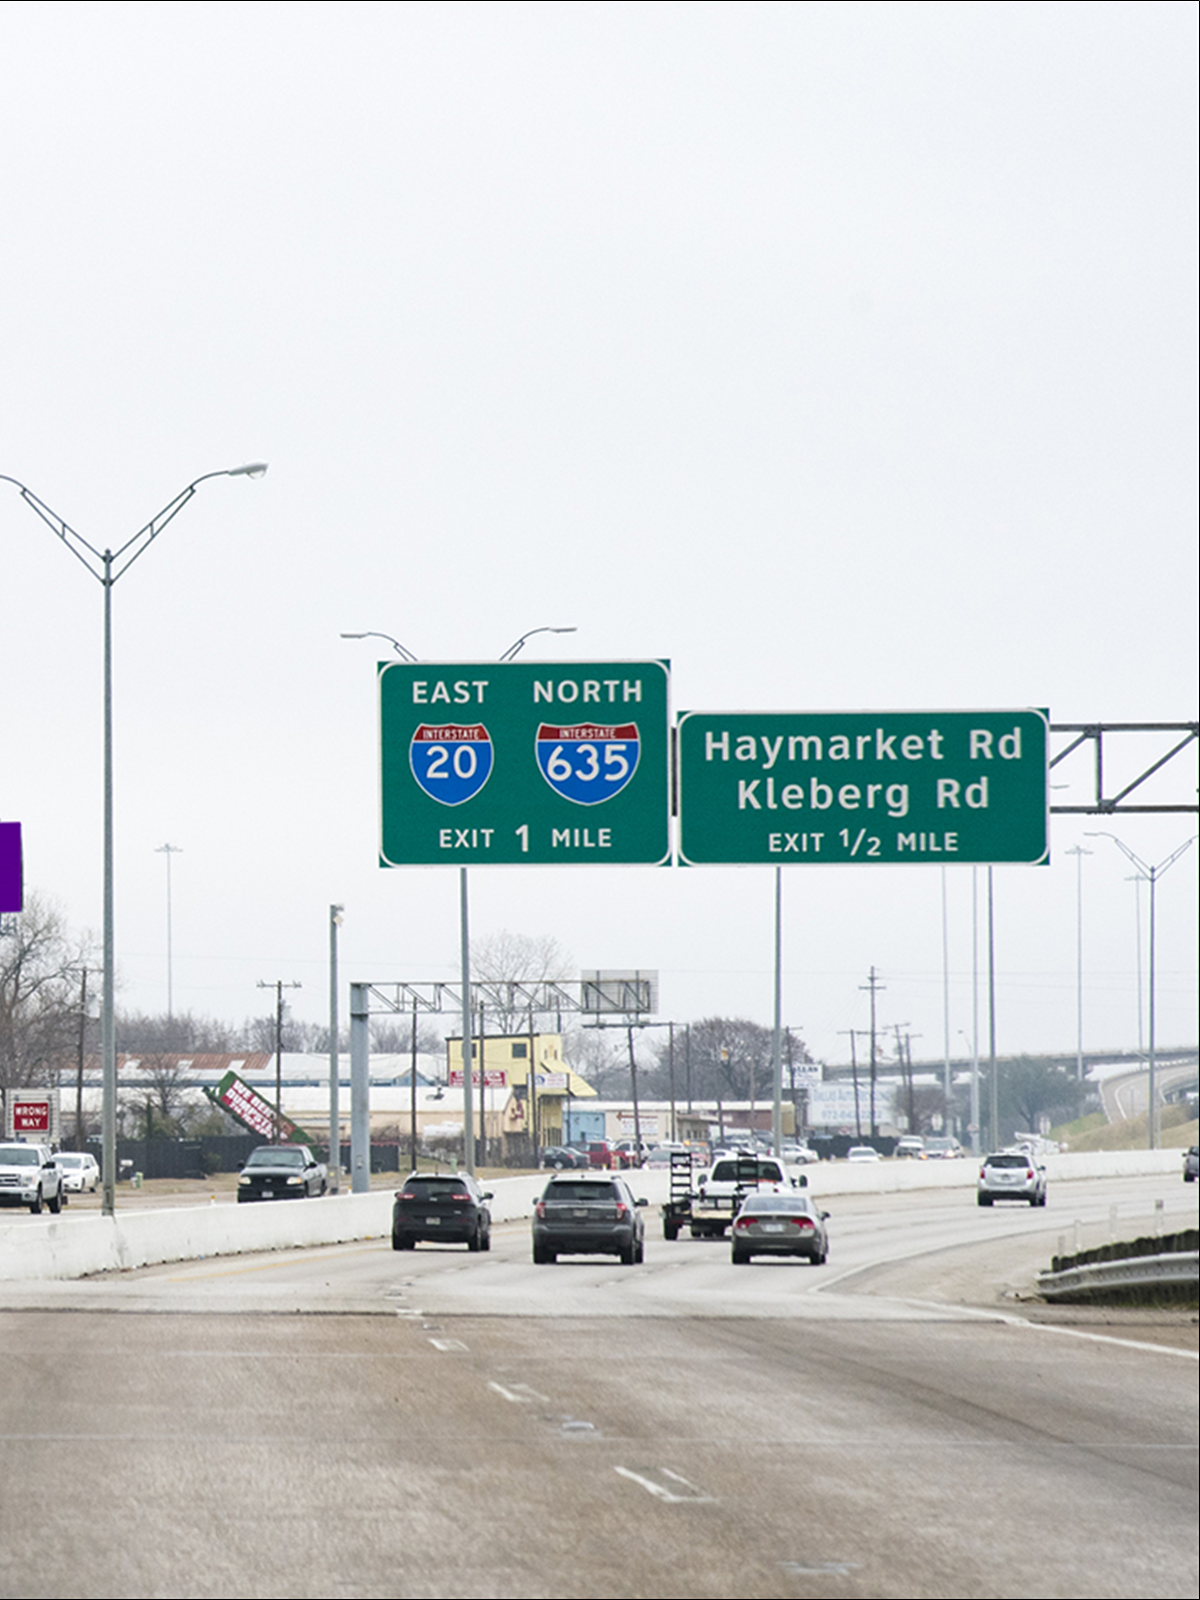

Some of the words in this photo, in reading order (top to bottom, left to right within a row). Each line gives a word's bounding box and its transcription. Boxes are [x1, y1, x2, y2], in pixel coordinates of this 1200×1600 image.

[412, 680, 489, 704] EAST
[533, 679, 642, 703] NORTH
[422, 729, 480, 740] INTERSTATE
[559, 728, 616, 739] INTERSTATE
[705, 728, 944, 770] Haymarket
[970, 726, 1021, 760] Rd
[426, 745, 477, 779] 20
[547, 743, 629, 782] 635
[738, 777, 909, 818] Kleberg
[937, 776, 988, 809] Rd
[439, 829, 495, 849] EXIT
[515, 824, 529, 852] 1
[552, 828, 612, 848] MILE
[769, 832, 824, 853] EXIT
[839, 828, 881, 856] 1/2
[897, 832, 958, 851] MILE
[15, 1106, 47, 1116] WRONG
[21, 1118, 41, 1127] WAY
